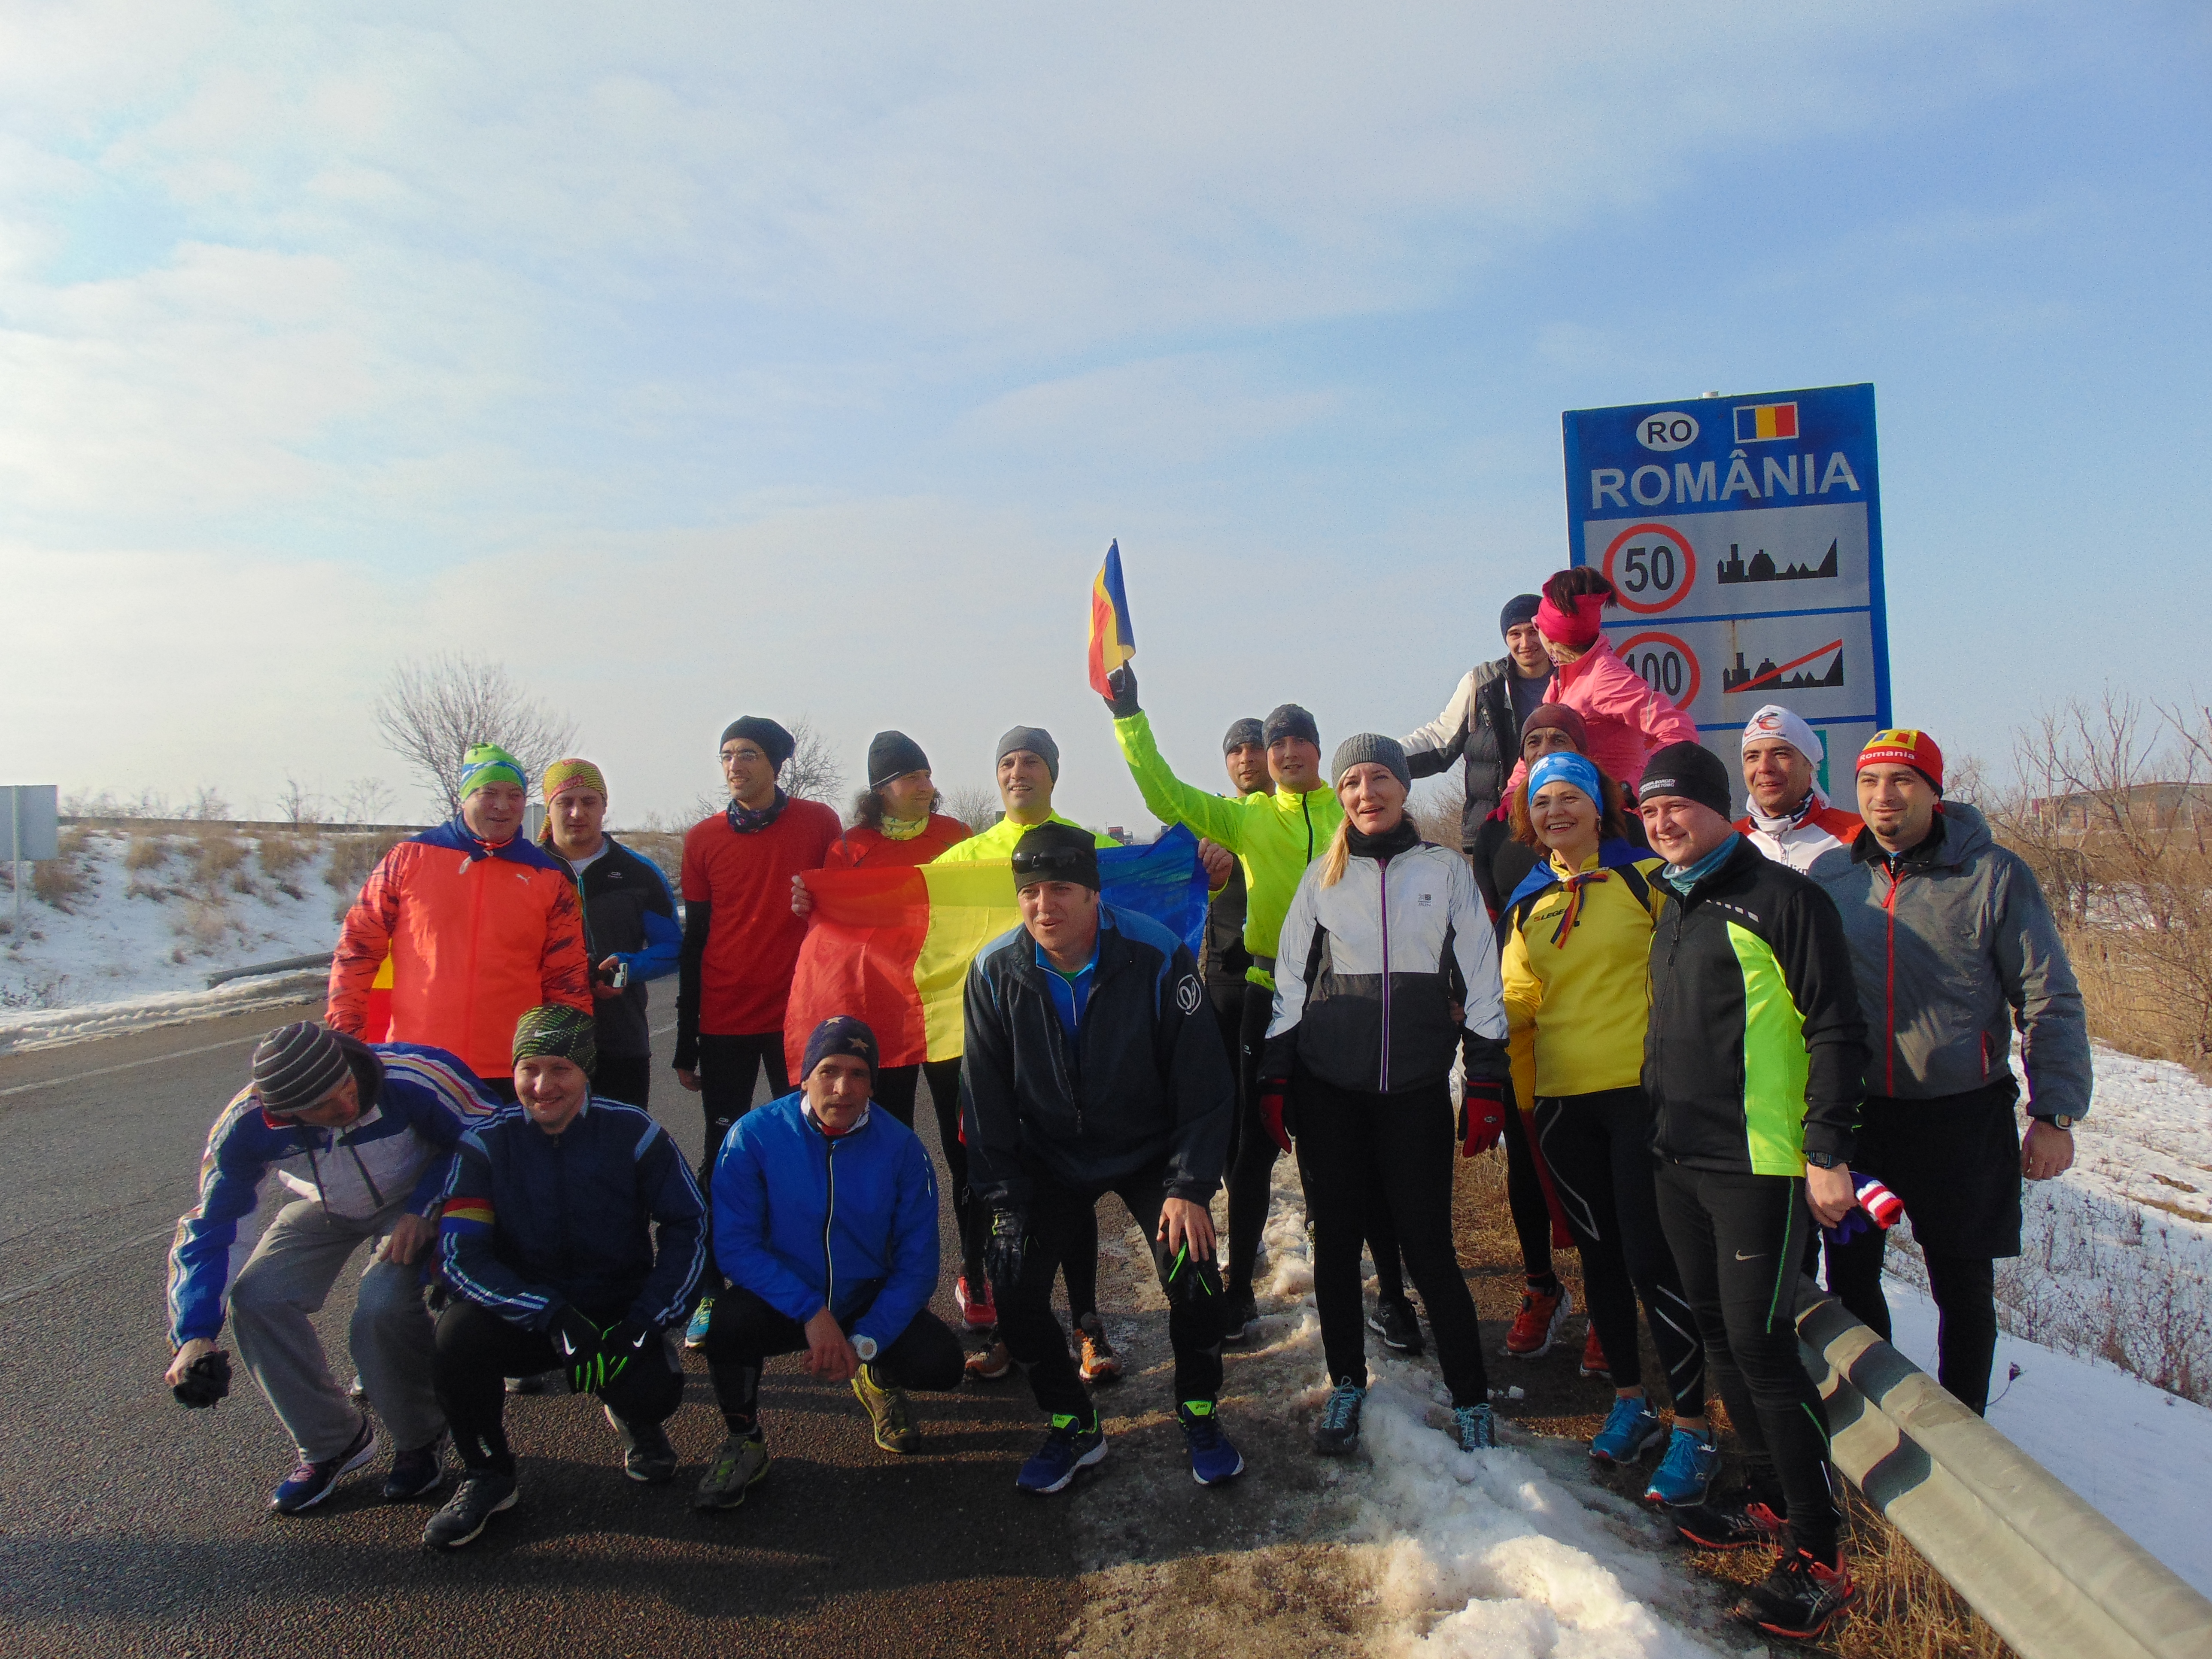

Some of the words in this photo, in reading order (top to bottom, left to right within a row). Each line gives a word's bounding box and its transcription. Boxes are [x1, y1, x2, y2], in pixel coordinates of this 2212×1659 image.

[1647, 419, 1692, 444] RO
[1591, 449, 1860, 509] ROMÂNIA
[1625, 545, 1674, 592] 50
[1860, 751, 1915, 762] Romania
[1540, 908, 1565, 920] LEGE
